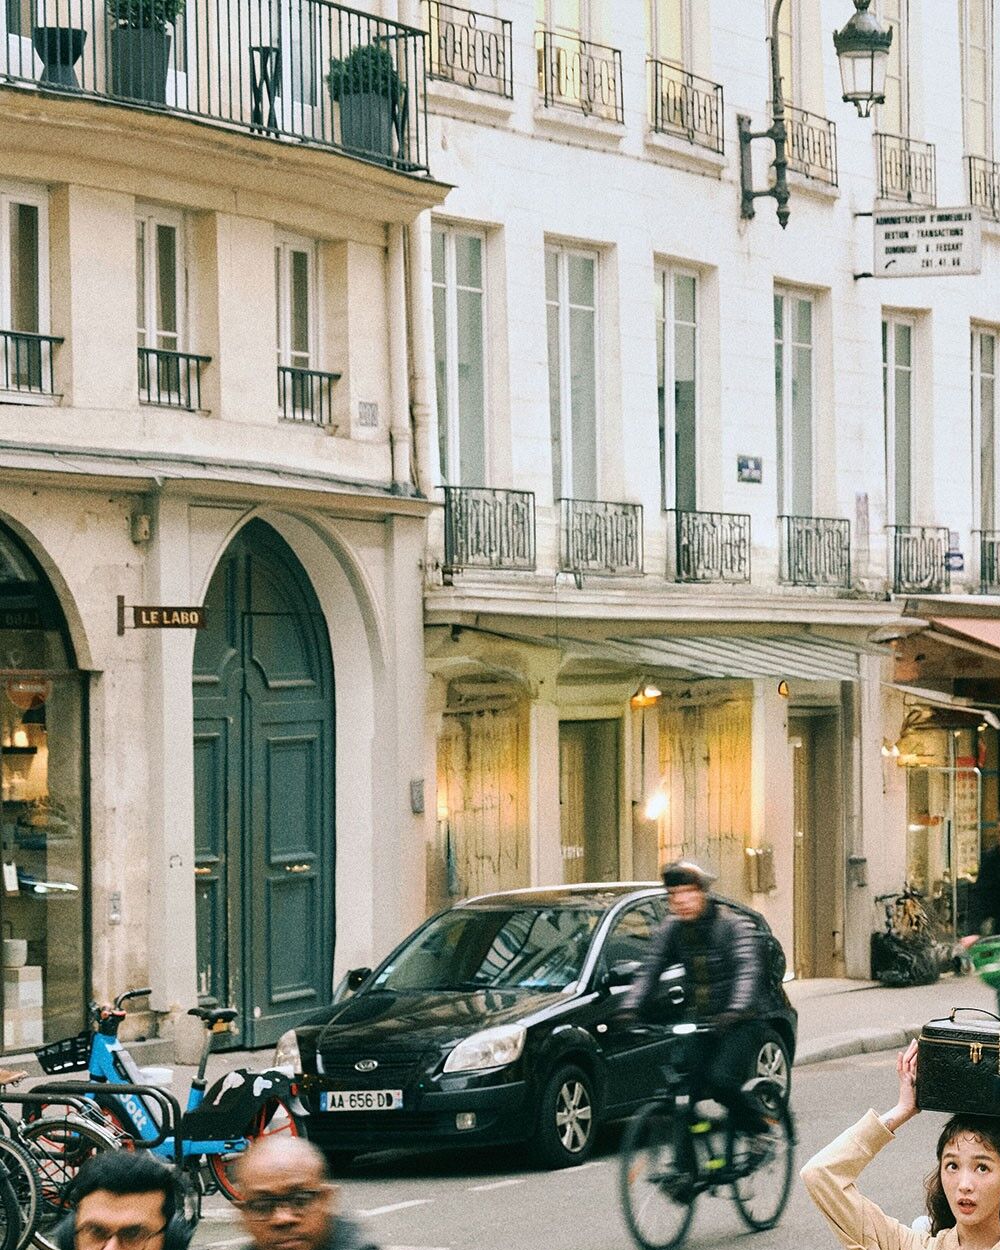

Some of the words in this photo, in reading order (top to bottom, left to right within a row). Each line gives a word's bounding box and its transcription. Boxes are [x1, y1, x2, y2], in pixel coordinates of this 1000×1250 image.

[917, 228, 964, 238] TRANSACTIONS
[141, 611, 159, 624] LE
[162, 611, 199, 624] LABO
